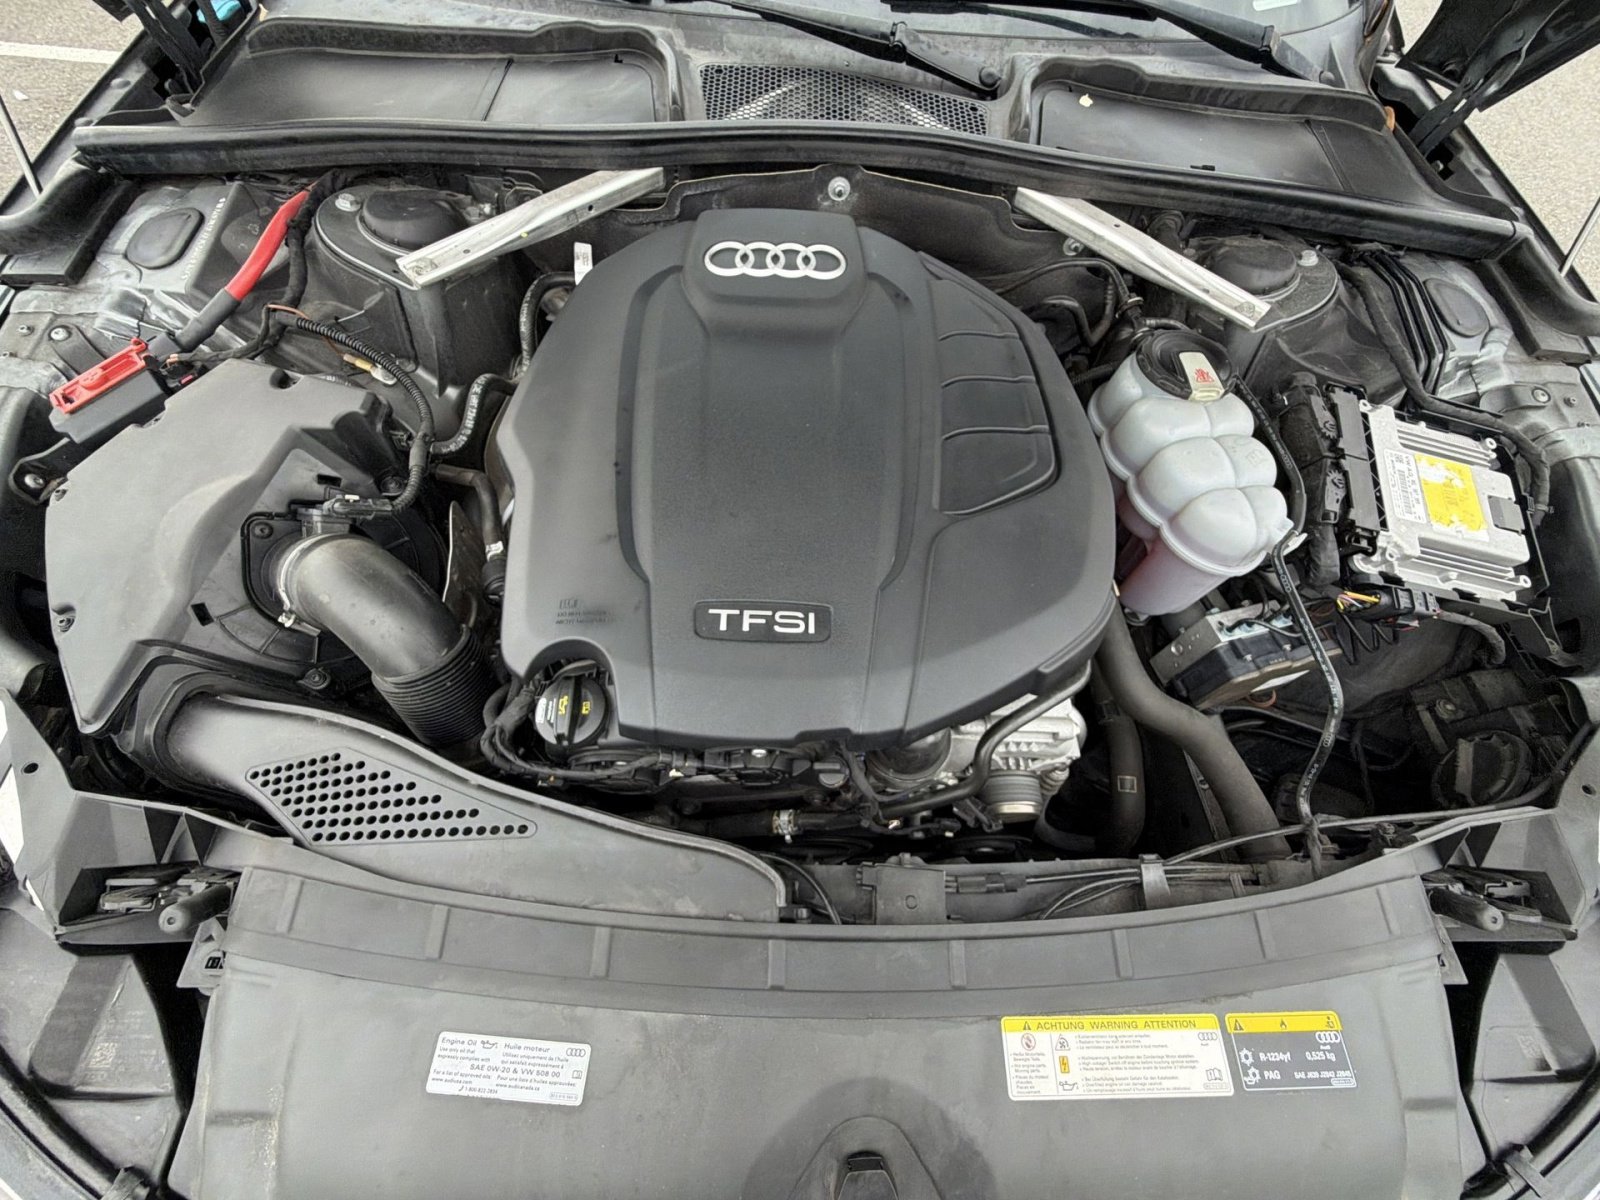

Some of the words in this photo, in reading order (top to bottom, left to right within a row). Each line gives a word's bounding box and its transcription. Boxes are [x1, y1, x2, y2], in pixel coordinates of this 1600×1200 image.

[708, 608, 816, 634] TFSI
[1036, 1022, 1084, 1030] ACHTUNG
[1090, 1020, 1138, 1030] WARNING
[1144, 1020, 1196, 1028] ATTENTION
[442, 1037, 465, 1046] Engine
[524, 1045, 550, 1053] moteur
[1259, 1052, 1291, 1062] R-1234yf
[1305, 1051, 1324, 1061] 0,525
[1325, 1051, 1336, 1061] kg
[486, 1066, 510, 1074] 0W-20
[1263, 1070, 1281, 1080] PAG
